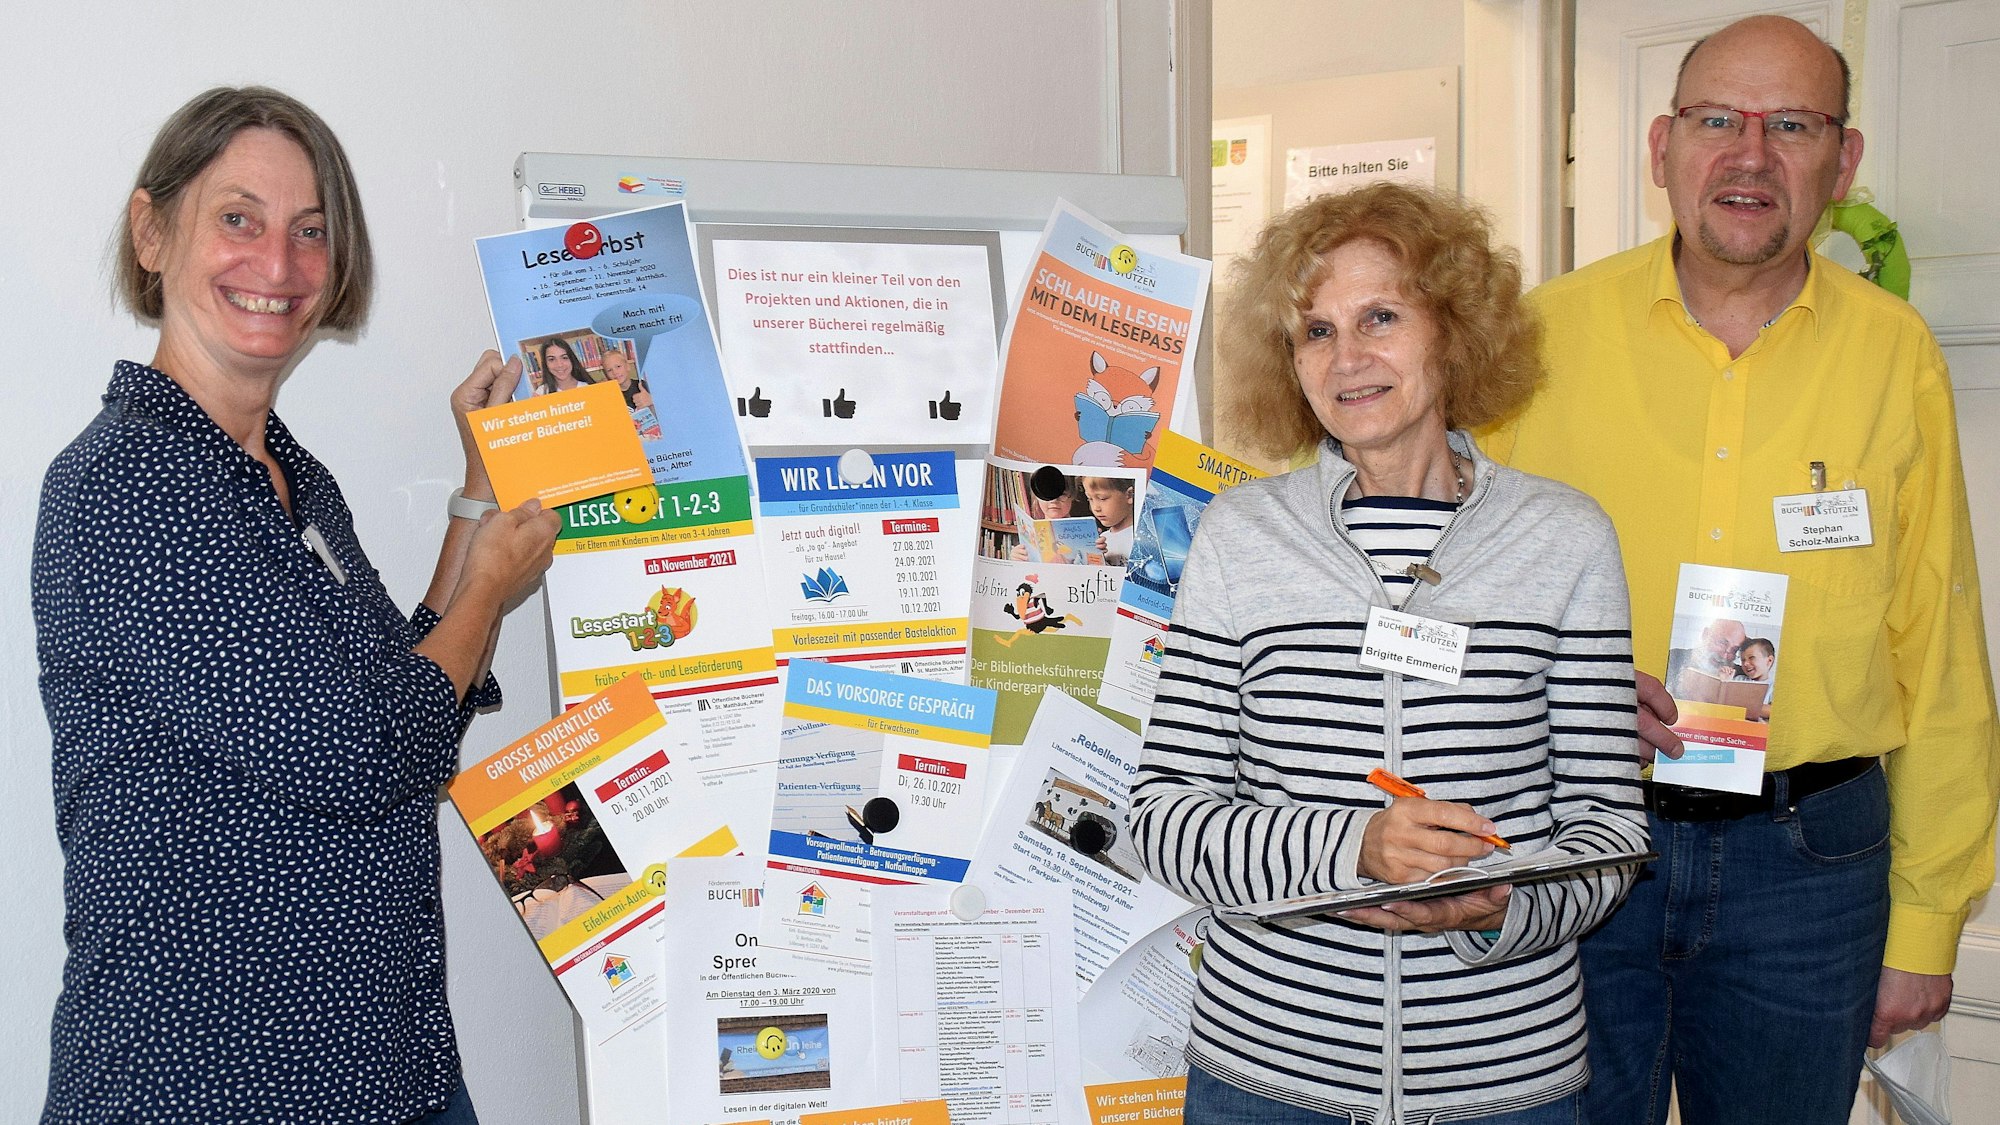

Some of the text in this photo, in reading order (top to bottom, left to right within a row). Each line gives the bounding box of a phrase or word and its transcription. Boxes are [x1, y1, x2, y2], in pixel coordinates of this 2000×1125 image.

[1309, 159, 1408, 177] Bitte halten Sie
[522, 232, 645, 269] Leserbst
[1076, 242, 1096, 259] BUCH
[613, 258, 642, 268] Schuljahr
[728, 268, 960, 288] Dies ist nur ein kleiner Teil von den
[554, 285, 593, 297] Öffentlichen
[597, 287, 636, 298] Kronenstraße
[745, 292, 948, 311] Projekten und Aktionen, die in
[1035, 268, 1121, 318] SCHLAUER
[1125, 304, 1189, 338] LESEN!
[622, 304, 665, 319] Mach mit!
[611, 314, 683, 334] Lesen macht fit!
[753, 318, 945, 335] unserer Bücherei regelmäßig
[1030, 286, 1059, 311] MIT
[1060, 300, 1098, 327] DEM
[1100, 315, 1184, 355] LESEPASS
[809, 342, 894, 355] stattfinden...
[482, 401, 586, 432] Wir stehen hinter
[489, 416, 592, 449] unserer Bücherei!
[656, 448, 693, 463] Bücherei
[670, 458, 693, 472] Alfter
[781, 467, 820, 492] WIR
[892, 463, 933, 487] VOR
[672, 491, 721, 517] 1-2-3
[913, 499, 933, 508] Klasse
[1823, 505, 1858, 515] STÜTZEN
[781, 522, 860, 542] Jetzt auch digital!
[890, 521, 931, 533] Termine:
[1803, 525, 1843, 535] Stephan
[892, 540, 934, 551] 27.08.2021
[1789, 535, 1860, 547] Scholz-Mainka
[648, 552, 733, 573] ab November 2021
[894, 556, 936, 567] 24.09.2021
[896, 571, 938, 582] 29.10.2021
[898, 586, 939, 598] 19.11.2021
[975, 579, 1008, 597] Ich bin
[1688, 591, 1712, 600] BUCH
[901, 602, 941, 614] 10.12.2021
[1733, 601, 1771, 613] STÜTZEN
[572, 611, 655, 635] Lesestart
[1378, 620, 1400, 630] BUCH
[628, 625, 673, 647] 1-2-3
[792, 626, 957, 645] Vorlesezeit mit passender Bastelaktion
[1421, 634, 1458, 648] STÜTZEN
[659, 659, 743, 678] und Leseförderung
[971, 658, 986, 671] Der
[1366, 647, 1458, 674] Brigitte Emmerich
[806, 678, 975, 720] DAS VORSORGE GESPRÄCH
[879, 722, 919, 735] Erwachsene
[486, 697, 614, 780] GROSSE ADVENTLICHE
[1726, 737, 1746, 745] Sache
[518, 728, 601, 784] KRIMILESUNG
[1052, 742, 1120, 787] Literarische Wanderung
[914, 758, 950, 775] Termin:
[614, 767, 651, 791] Termin:
[778, 782, 861, 791] Patienten-Verfügung
[898, 774, 962, 795] Di, 26.10.2021
[1085, 772, 1108, 790] Wilhelm
[611, 803, 626, 816] Di,
[625, 772, 673, 809] 30.11.2021
[911, 794, 946, 809] 19.30 Uhr
[632, 795, 670, 824] 20.00 Uhr
[806, 837, 935, 866] Vorsorgevollmacht Betreuungsverfügung
[817, 851, 928, 876] Patientenverfügung Notfallmappe
[1018, 830, 1132, 897] Samstag, 18. September 2021
[1012, 842, 1134, 911] Start um 13.30 Uhr am Friedhof Alfter
[708, 888, 741, 901] BUCH
[582, 888, 651, 933] Eifelkrimi-Auto
[721, 990, 755, 999] Dienstag
[782, 987, 800, 995] März
[723, 1105, 747, 1114] Lesen
[759, 1104, 772, 1112] der
[773, 1102, 806, 1112] digitalen
[808, 1101, 828, 1109] Welt!
[1096, 1093, 1154, 1108] Wir stehen
[1100, 1111, 1139, 1124] unserer
